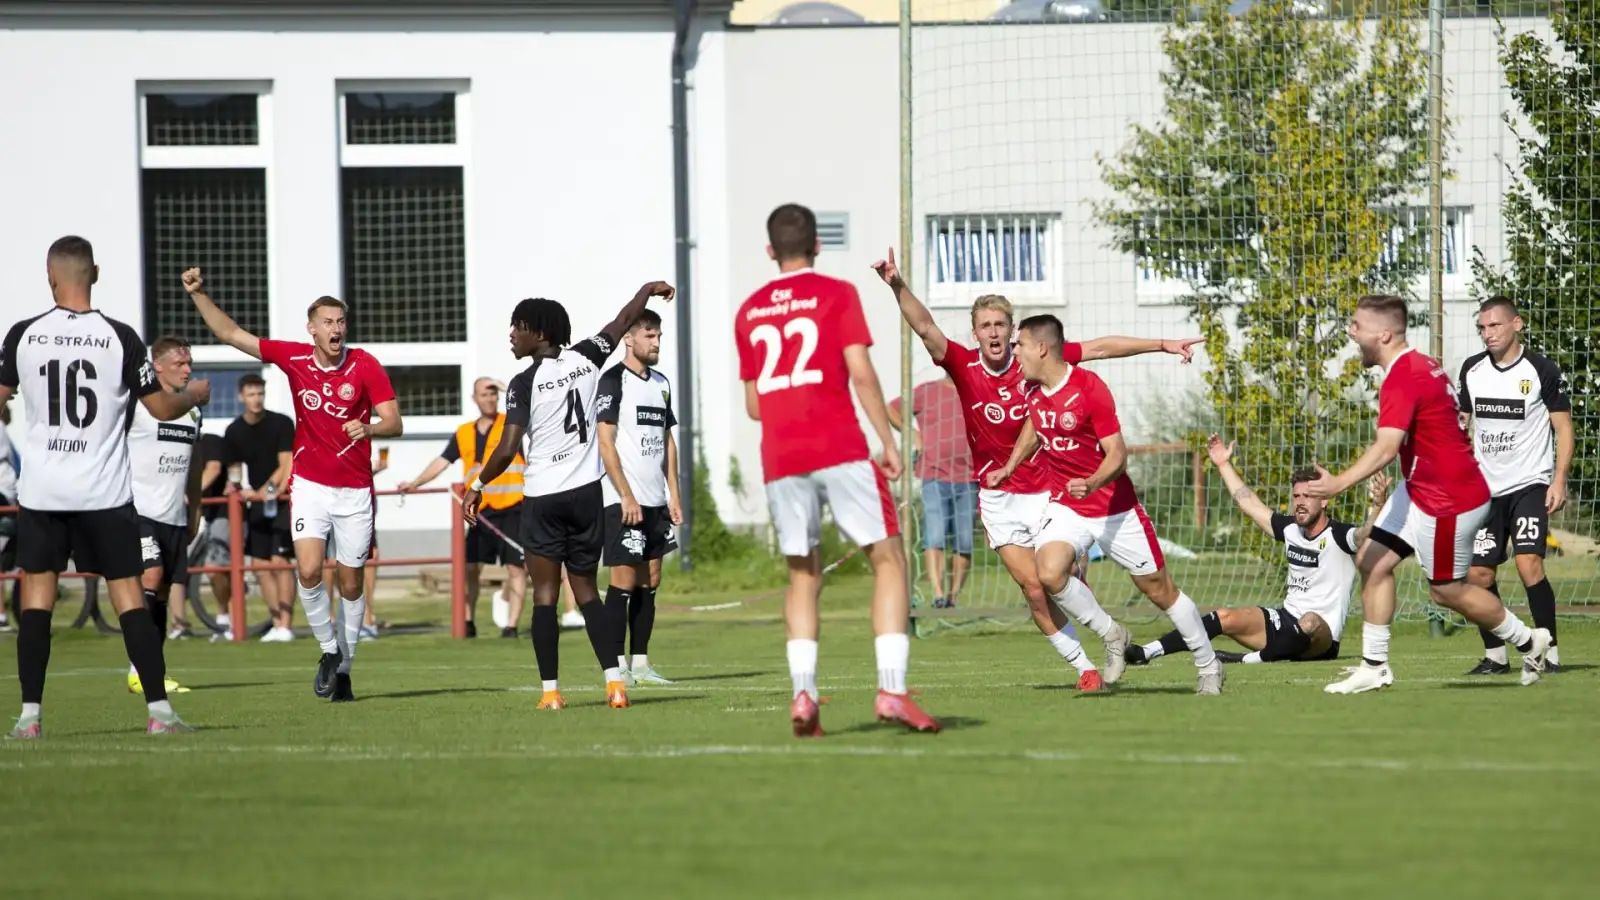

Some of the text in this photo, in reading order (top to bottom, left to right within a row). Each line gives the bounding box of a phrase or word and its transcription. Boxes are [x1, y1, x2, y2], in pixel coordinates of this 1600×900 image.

[790, 296, 818, 312] Brod
[28, 334, 112, 349] FC STRÁNÍ
[749, 317, 823, 395] 22
[39, 359, 98, 429] 16
[322, 382, 333, 397] 6
[537, 381, 555, 393] FC
[997, 386, 1012, 401] 5
[323, 401, 349, 419] CZ
[563, 388, 590, 444] 4
[1475, 403, 1524, 414] STAVBA.cz
[1037, 408, 1057, 429] 17
[1052, 436, 1080, 451] CZ
[295, 518, 305, 532] 6
[1516, 516, 1540, 540] 25
